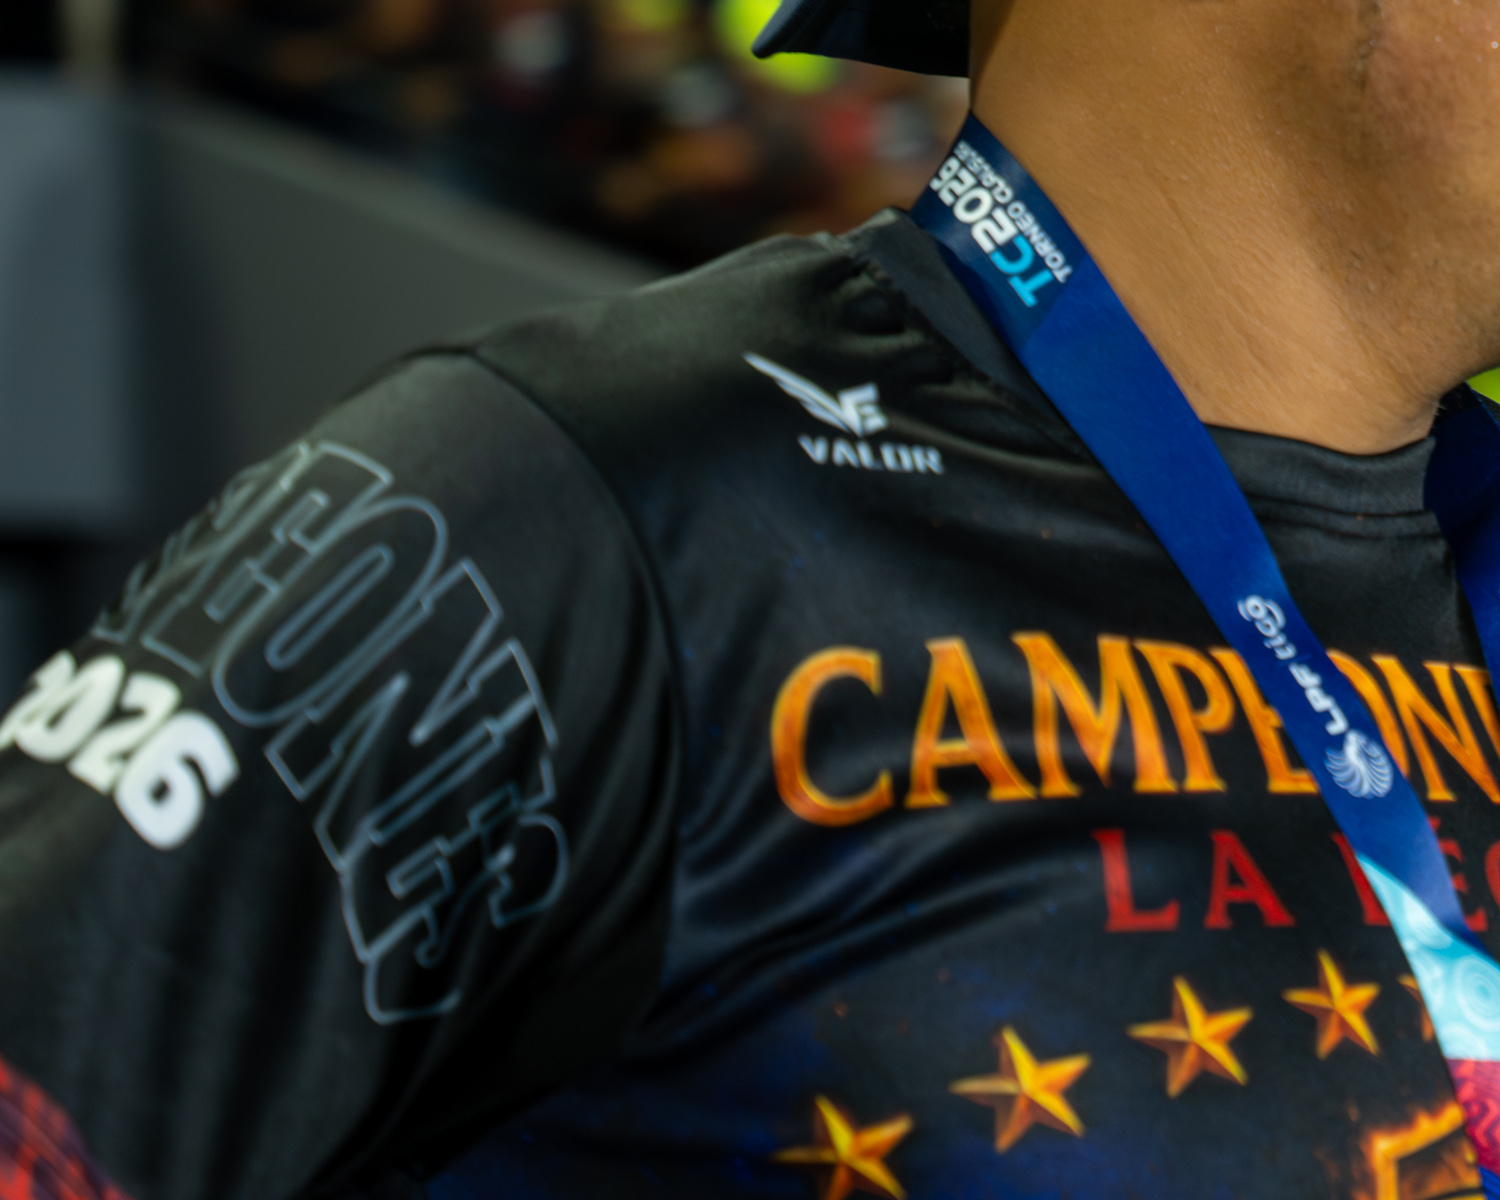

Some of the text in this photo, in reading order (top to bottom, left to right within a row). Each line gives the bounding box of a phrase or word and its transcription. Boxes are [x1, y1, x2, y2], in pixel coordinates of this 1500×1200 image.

[1007, 200, 1073, 283] TORNEO
[798, 434, 944, 475] VALOR
[1289, 662, 1349, 736] LPF
[1090, 827, 1296, 933] LA
